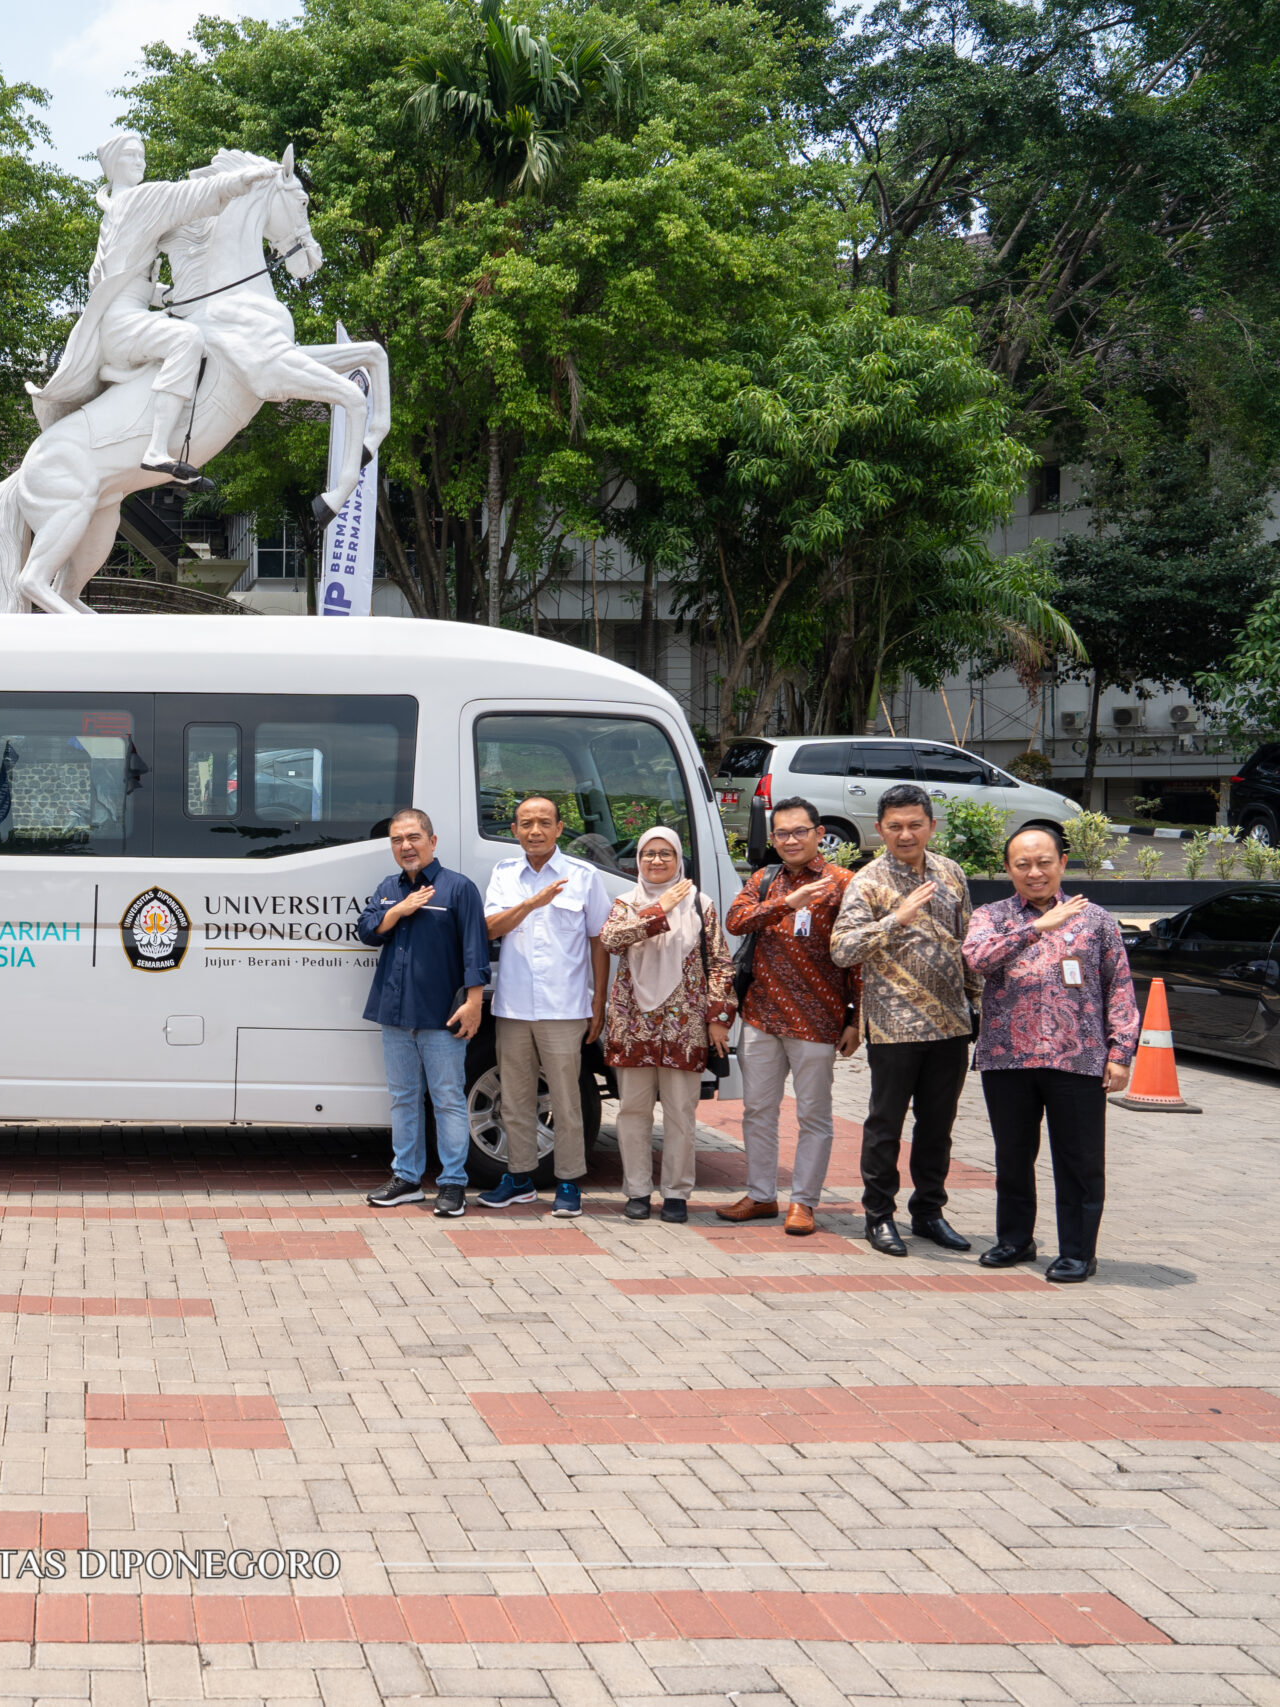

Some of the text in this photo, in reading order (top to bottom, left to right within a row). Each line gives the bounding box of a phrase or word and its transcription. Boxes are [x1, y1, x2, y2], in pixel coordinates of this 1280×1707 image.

[124, 890, 188, 927] UNIVERSITAS DIPONEGORO
[136, 959, 175, 968] SEMARANG
[248, 957, 290, 967] Berani
[302, 957, 342, 967] Peduli
